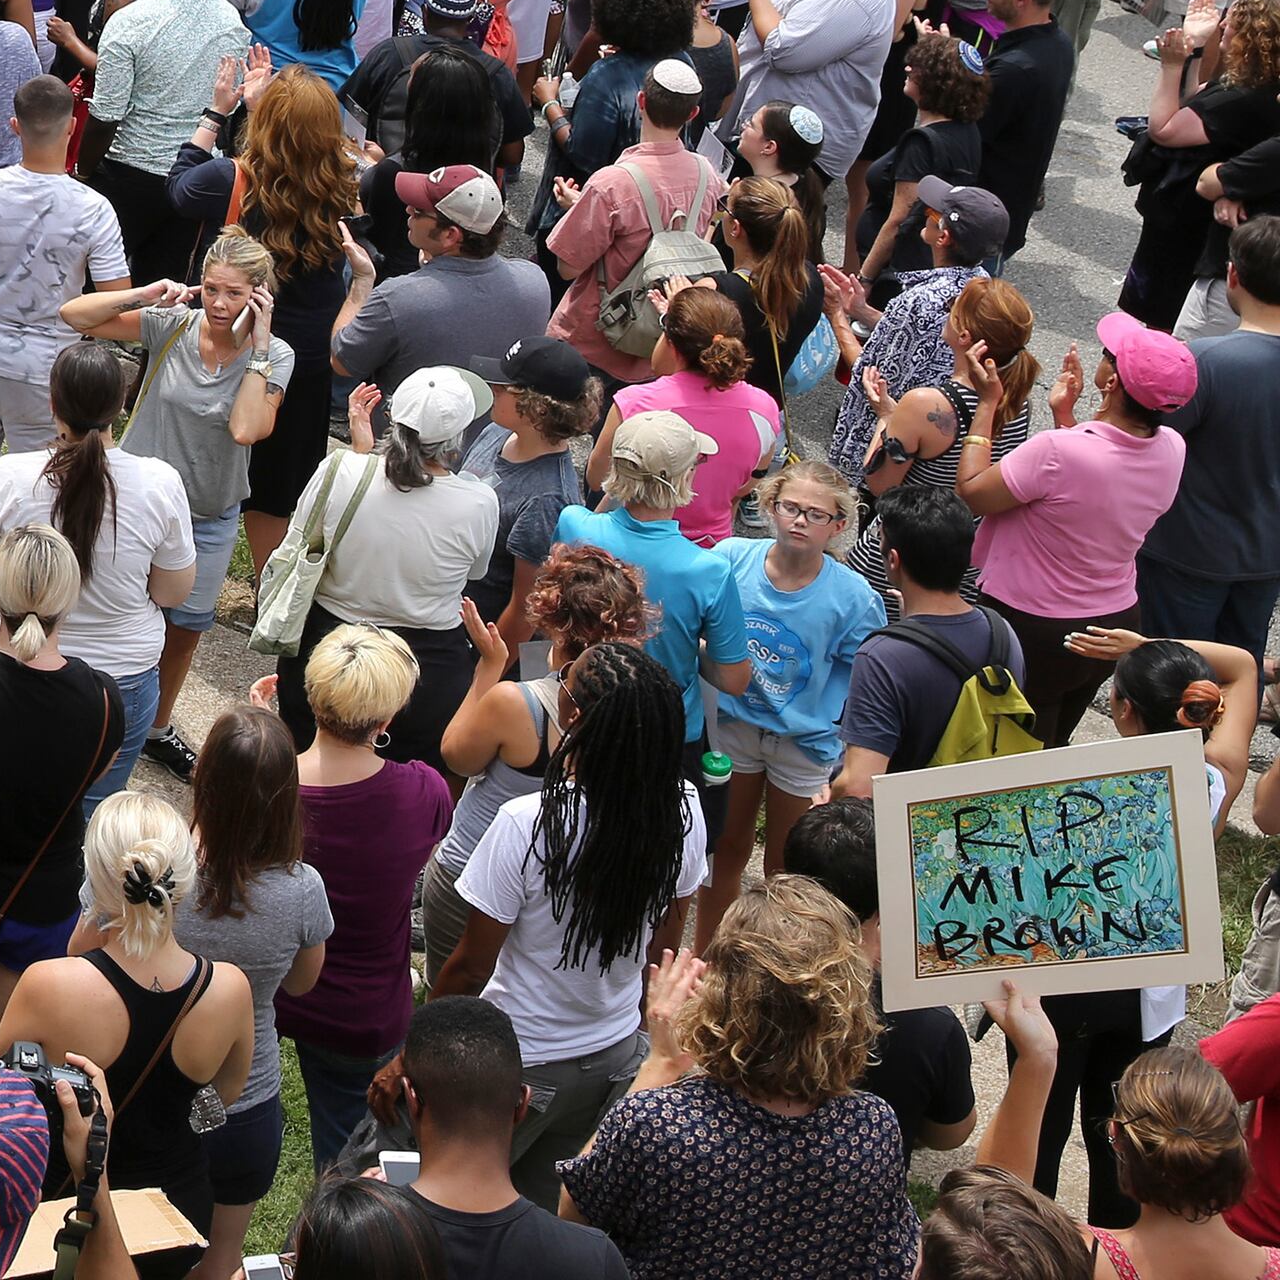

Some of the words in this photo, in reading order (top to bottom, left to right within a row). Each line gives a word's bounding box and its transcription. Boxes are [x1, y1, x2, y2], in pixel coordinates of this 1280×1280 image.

[952, 791, 1105, 864] RIP
[940, 855, 1130, 911] MIKE
[934, 900, 1147, 961] BROWN
